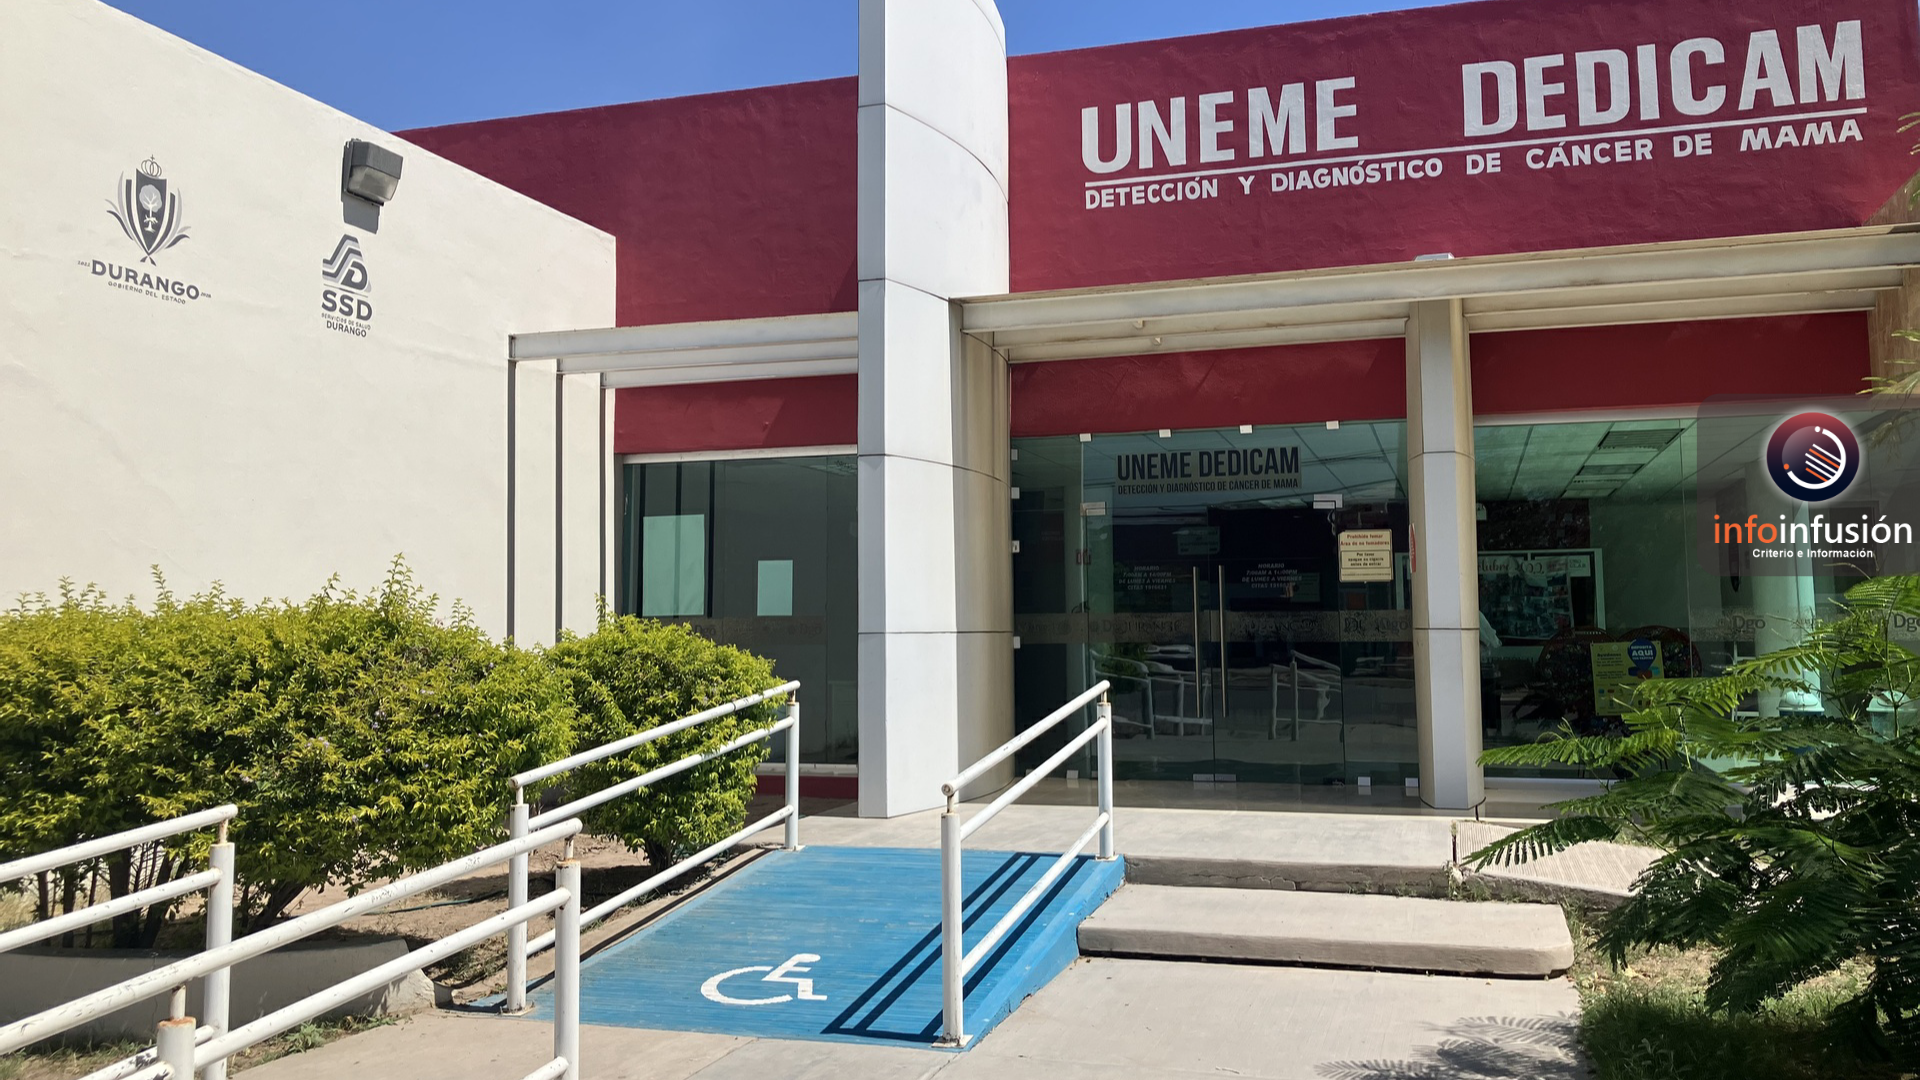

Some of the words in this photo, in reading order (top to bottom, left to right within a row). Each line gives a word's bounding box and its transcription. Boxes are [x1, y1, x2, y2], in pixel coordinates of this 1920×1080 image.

[1081, 76, 1359, 174] UNEME
[1462, 19, 1866, 137] DEDICAM
[1085, 177, 1218, 209] DETECCIÓN
[1238, 175, 1255, 195] Y
[1271, 158, 1443, 193] DIAGNÓSTICO
[1466, 152, 1501, 175] DE
[1525, 140, 1654, 170] CÁNCER
[1673, 133, 1712, 158] DE
[1740, 119, 1863, 152] MAMA
[91, 259, 200, 300] DURANGO
[108, 281, 143, 294] GOBIERNO
[145, 290, 158, 298] DEL
[161, 294, 186, 305] ESTADO
[321, 289, 373, 321] SSD
[321, 313, 347, 324] SERVICIOS
[355, 322, 371, 331] SALUD
[326, 320, 367, 338] DURANGO
[1117, 452, 1192, 481] UNEME
[1199, 447, 1299, 477] DEDICAM
[1118, 483, 1158, 495] DETECCIÓN
[1160, 485, 1165, 494] Y
[1166, 481, 1216, 493] DIAGNÓSTICO
[1217, 481, 1227, 491] DE
[1229, 479, 1260, 490] CÁNCER
[1261, 479, 1271, 489] DE
[1273, 478, 1298, 488] MAMA
